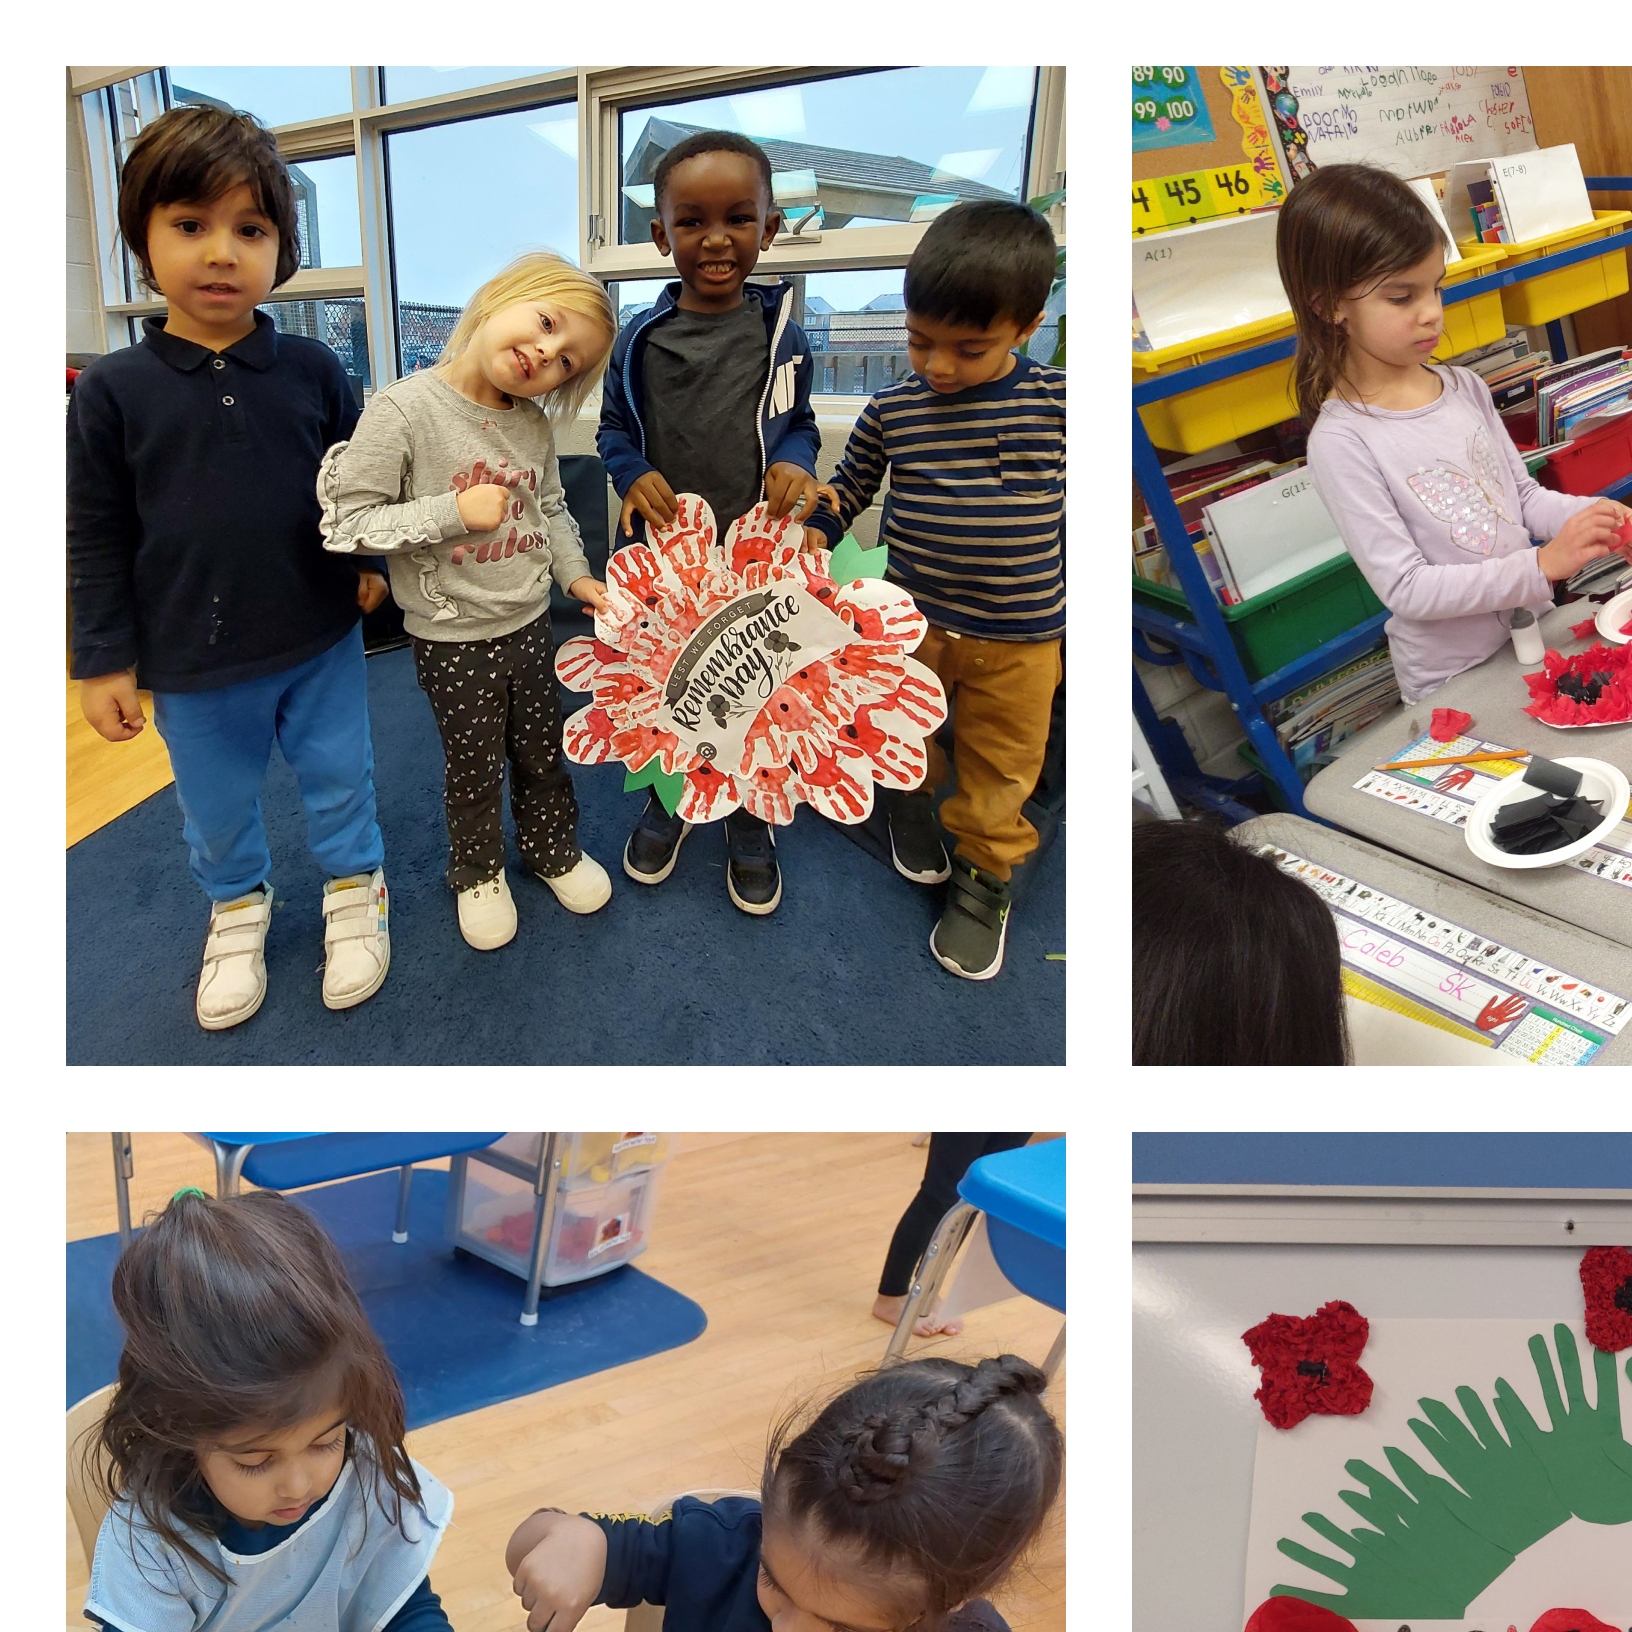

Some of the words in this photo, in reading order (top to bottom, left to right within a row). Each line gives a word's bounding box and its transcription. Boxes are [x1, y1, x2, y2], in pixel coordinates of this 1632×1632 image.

[1132, 66, 1154, 81] 89
[1162, 67, 1185, 83] 90
[1135, 101, 1157, 119] 99
[1166, 101, 1194, 118] 100
[1503, 165, 1527, 177] E(7-8)
[1165, 178, 1202, 207] 45
[1215, 170, 1250, 197] 46
[1145, 248, 1173, 261] A(1)
[670, 659, 690, 688] LEST
[690, 640, 705, 655] WE
[707, 602, 753, 636] FORGET
[672, 595, 800, 732] Remembrance
[718, 647, 773, 698] Day
[1341, 928, 1405, 969] Caleb
[1439, 972, 1476, 1000] SK
